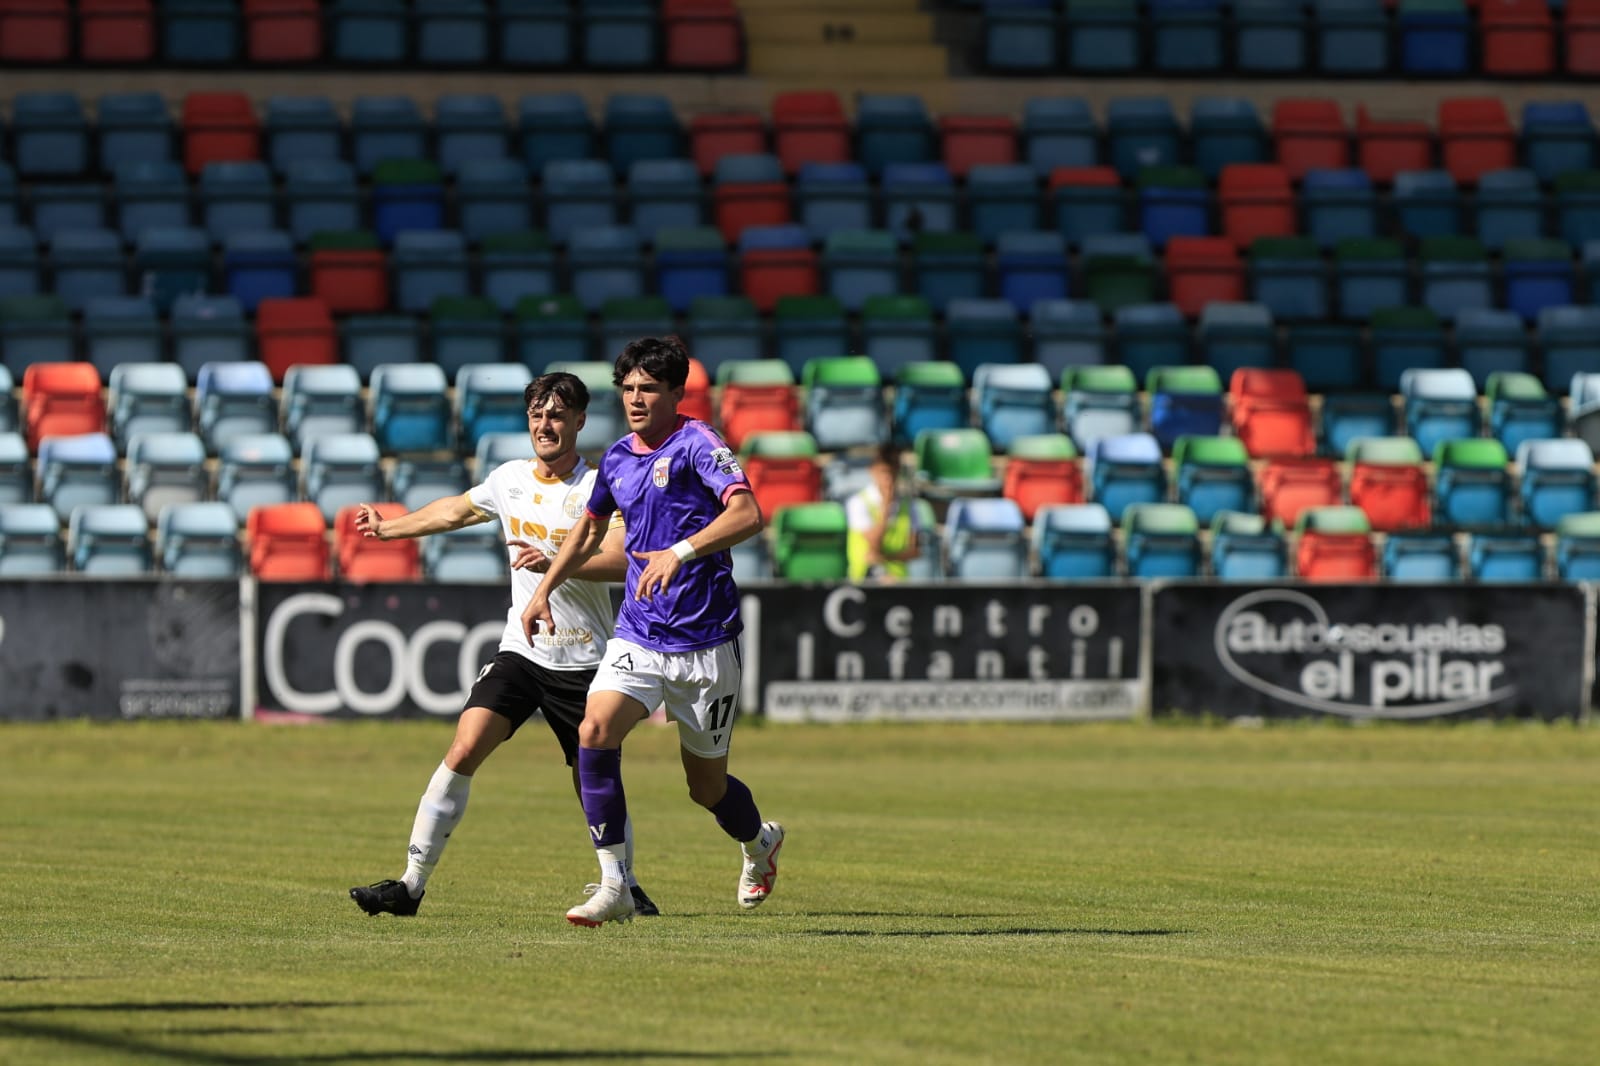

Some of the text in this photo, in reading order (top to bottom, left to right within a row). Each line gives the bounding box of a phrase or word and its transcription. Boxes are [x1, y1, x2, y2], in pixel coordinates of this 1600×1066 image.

[539, 627, 586, 637] MXIMO
[823, 587, 1099, 637] Centro
[798, 632, 1124, 681] Infantil
[1301, 650, 1505, 711] el pilar
[709, 694, 734, 731] 17
